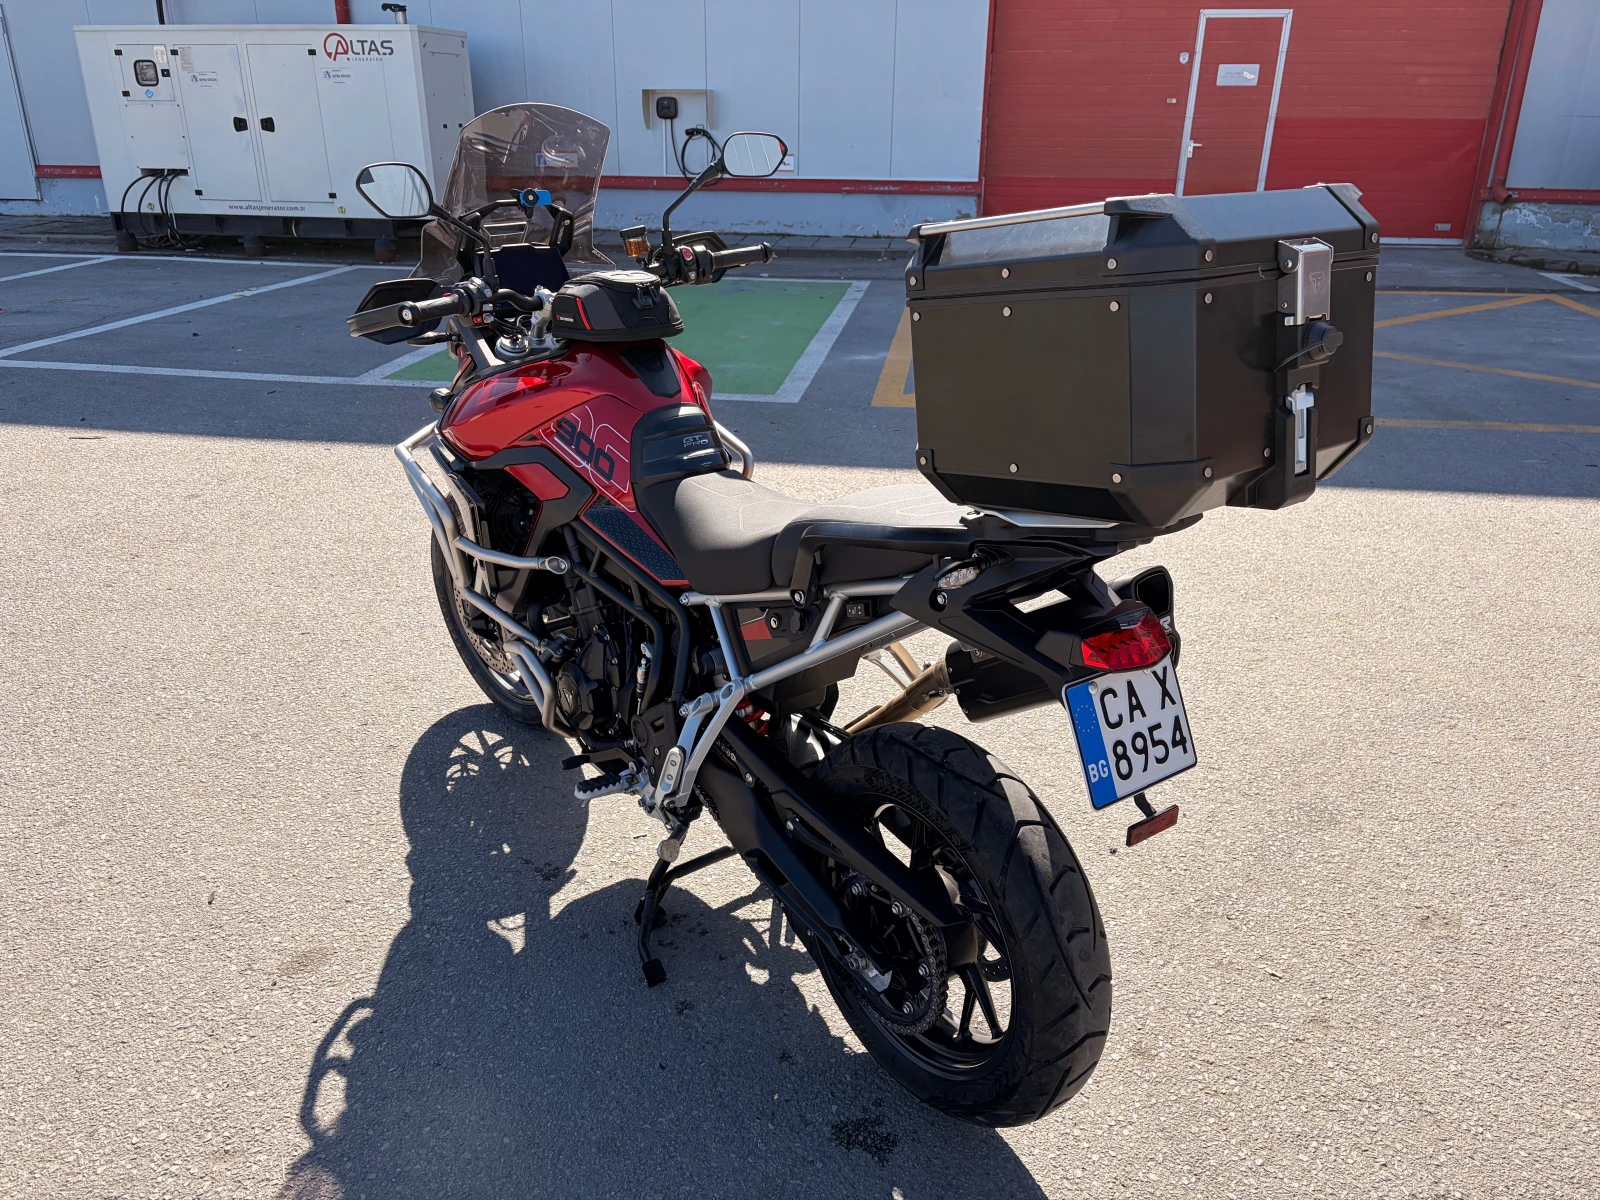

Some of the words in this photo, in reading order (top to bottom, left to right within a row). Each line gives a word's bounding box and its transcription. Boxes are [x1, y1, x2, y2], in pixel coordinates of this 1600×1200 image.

[323, 32, 394, 61] ALTAS
[556, 416, 615, 481] 900
[683, 439, 709, 448] PRO
[1099, 679, 1147, 730] CA
[1152, 666, 1176, 710] X
[1112, 715, 1189, 781] 8954
[1087, 760, 1109, 784] BG
